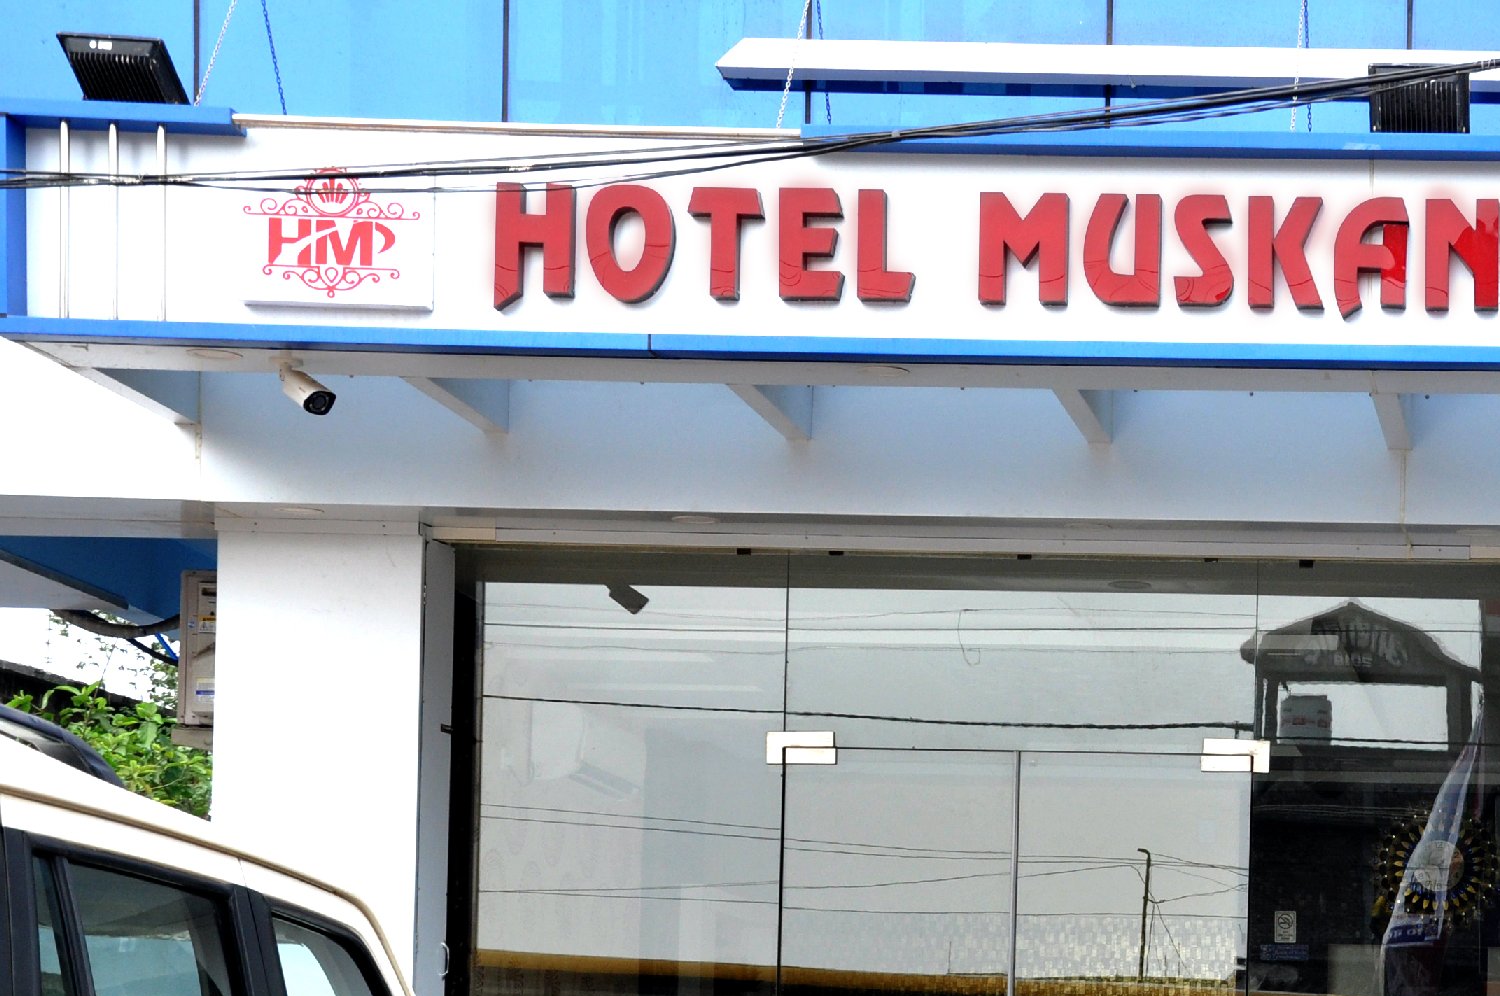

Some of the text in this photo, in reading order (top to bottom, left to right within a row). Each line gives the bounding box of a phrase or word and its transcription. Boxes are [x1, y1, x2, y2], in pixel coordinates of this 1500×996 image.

[267, 216, 396, 267] HMP
[494, 182, 915, 309] HOTEL
[978, 192, 1500, 320] MUSKAN
